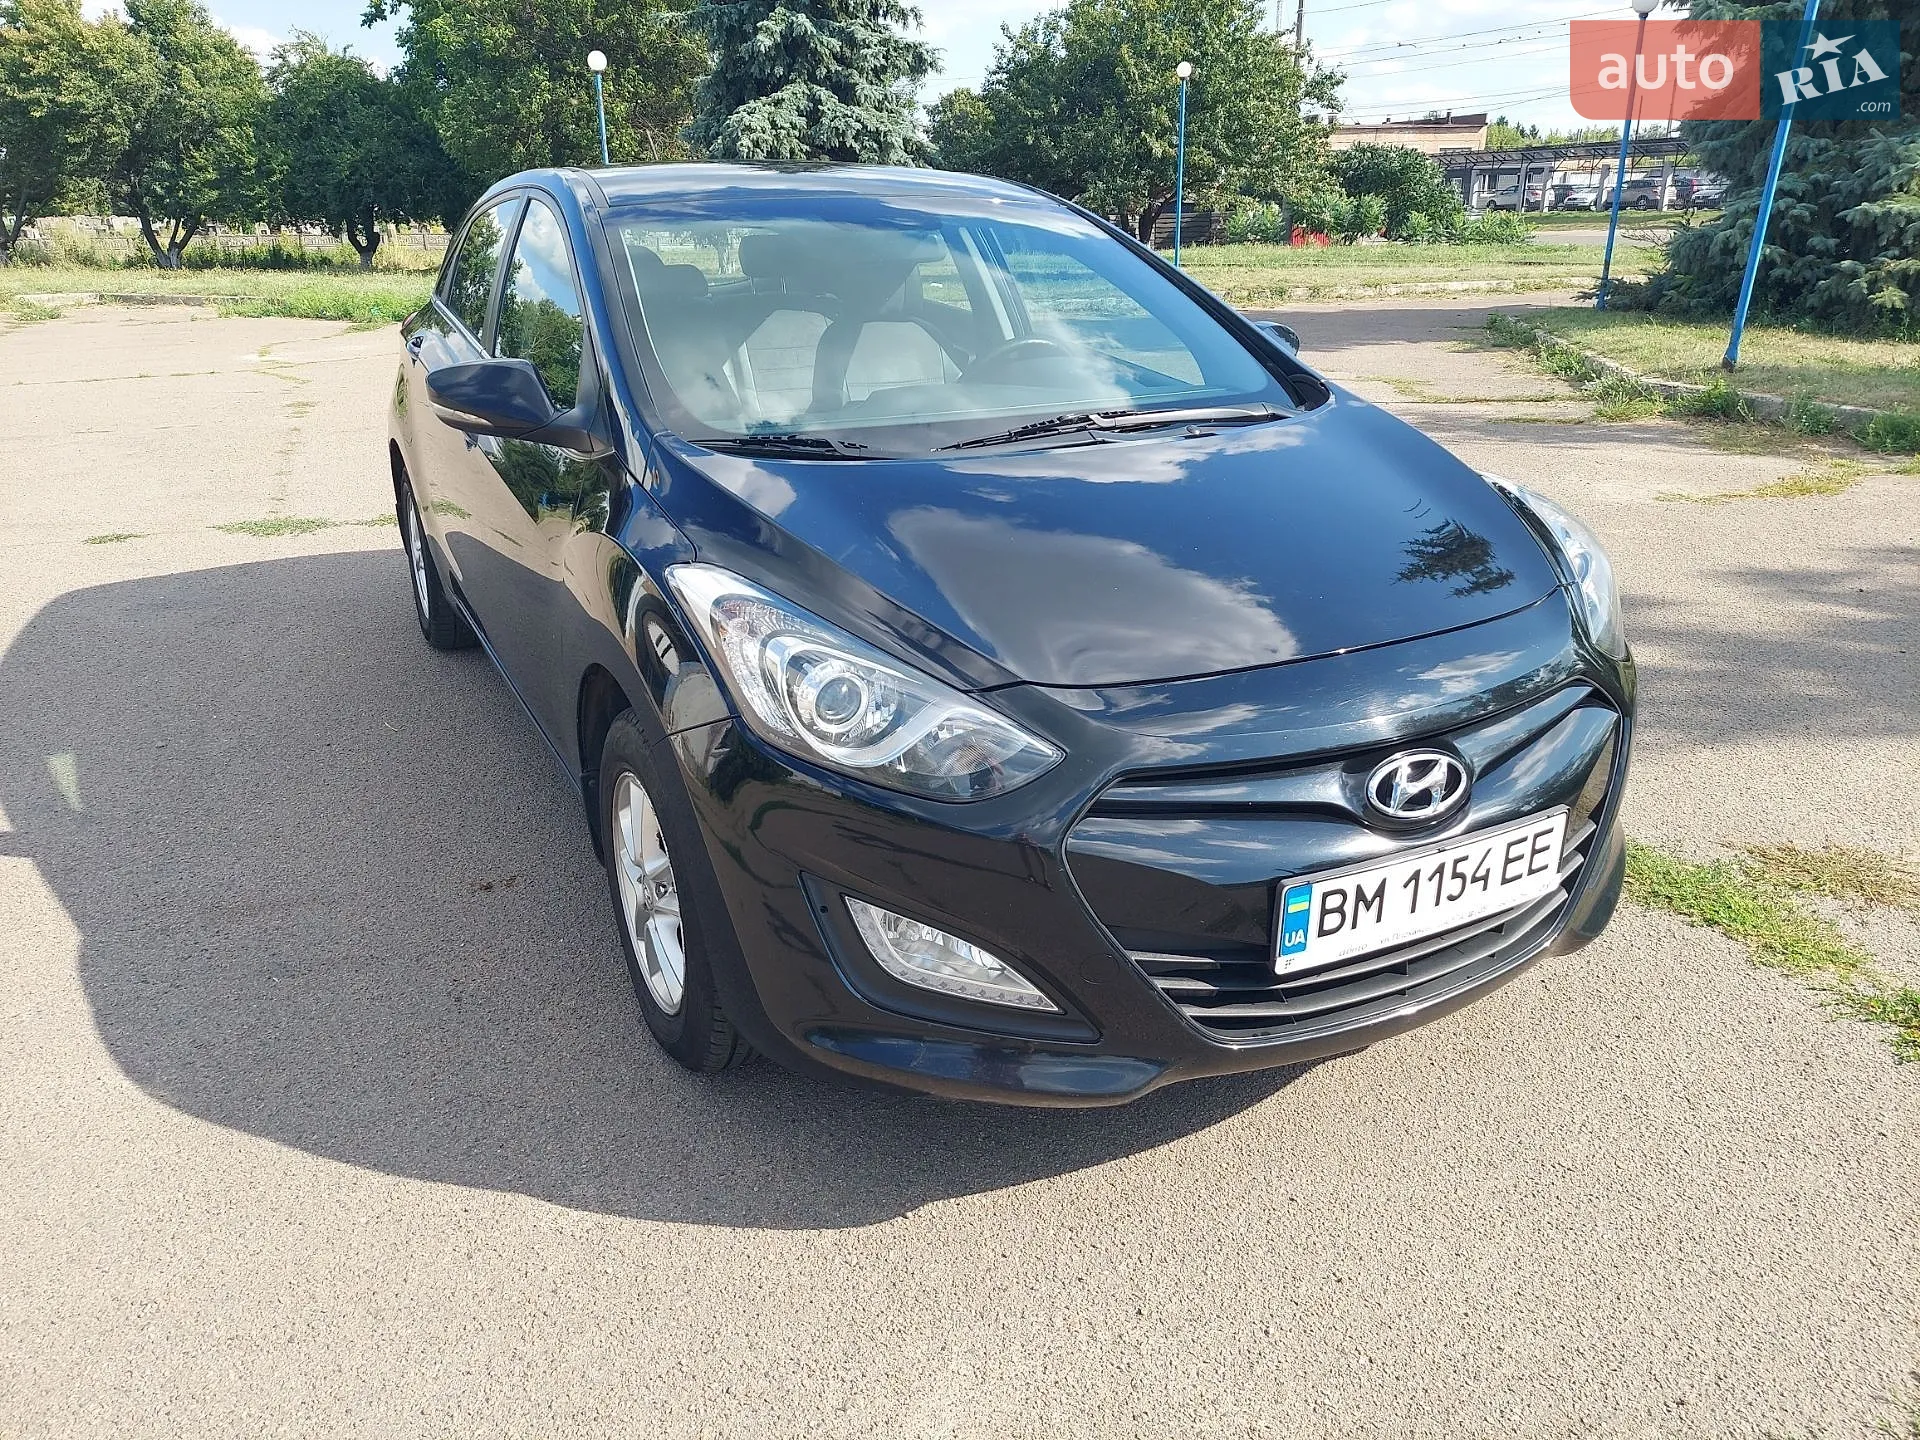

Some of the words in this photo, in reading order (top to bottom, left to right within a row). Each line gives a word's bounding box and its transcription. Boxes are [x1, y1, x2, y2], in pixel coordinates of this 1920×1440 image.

[1317, 877, 1387, 938] BM
[1402, 847, 1493, 914] 1154
[1500, 827, 1555, 886] EE
[1284, 929, 1306, 947] UA
